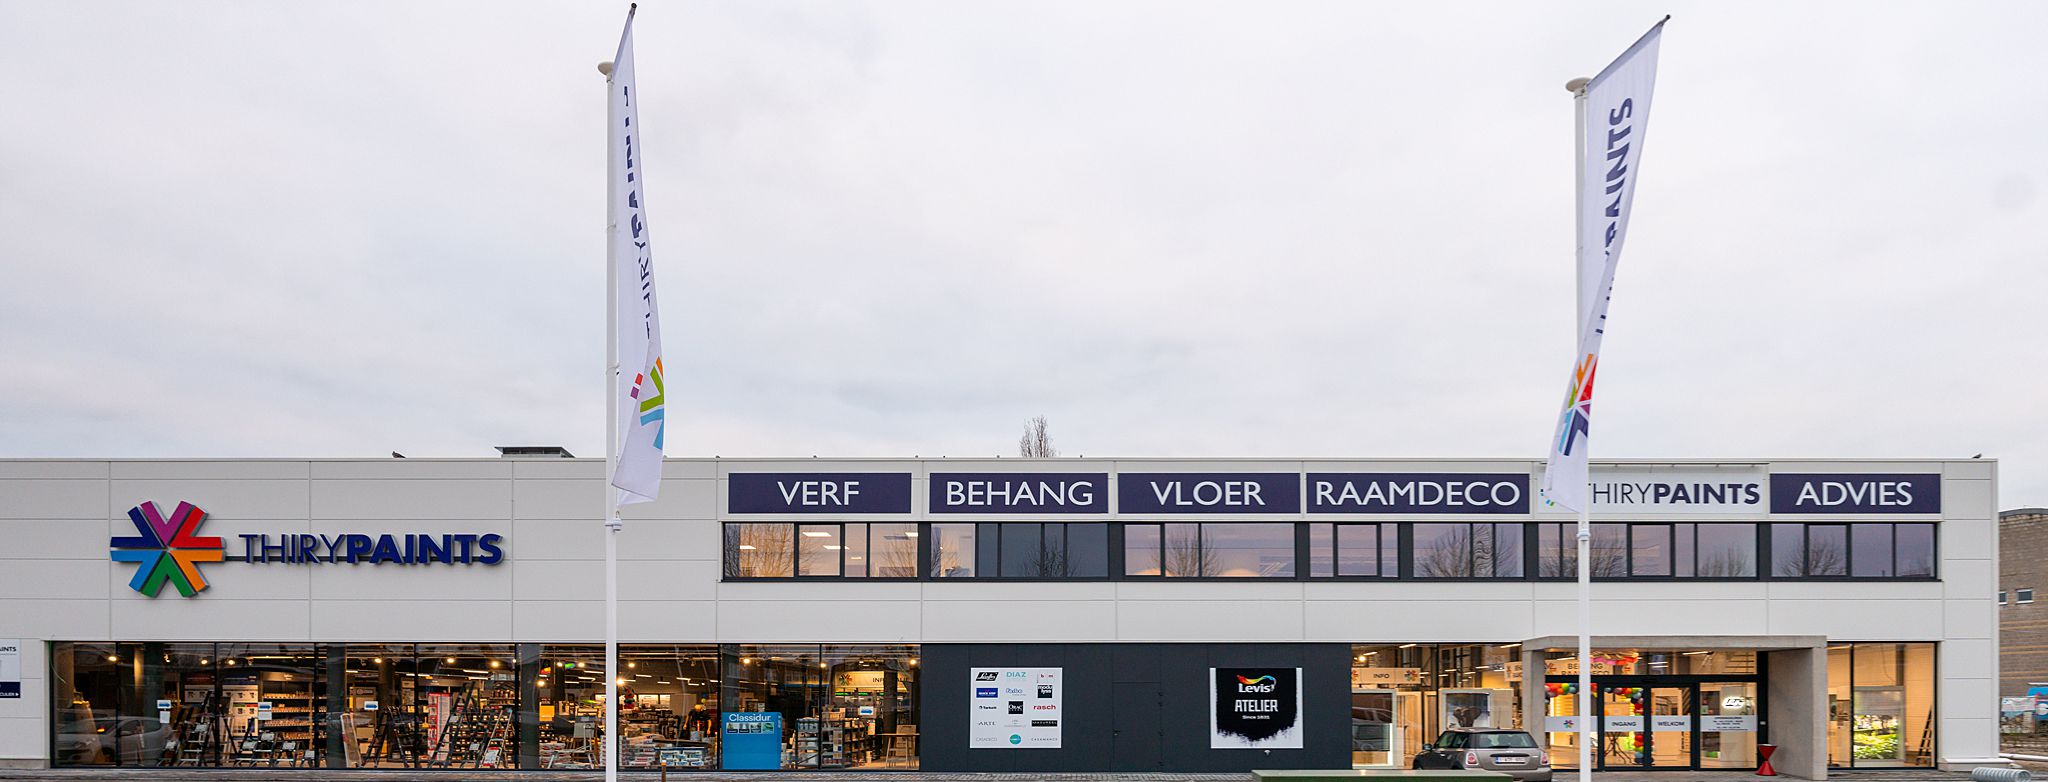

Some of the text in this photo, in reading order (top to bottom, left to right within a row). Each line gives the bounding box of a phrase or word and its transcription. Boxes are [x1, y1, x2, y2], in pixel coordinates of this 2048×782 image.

[777, 481, 860, 506] VERF
[946, 481, 1094, 506] BEHANG
[1150, 481, 1266, 506] VLOER
[1316, 481, 1520, 506] RAAMDECO
[1588, 483, 1761, 505] HIRYPAINTS
[1795, 481, 1913, 506] ADVIES
[238, 533, 505, 566] THIRYPAINTS
[728, 713, 772, 722] Classidur
[1234, 699, 1279, 712] ATELIER
